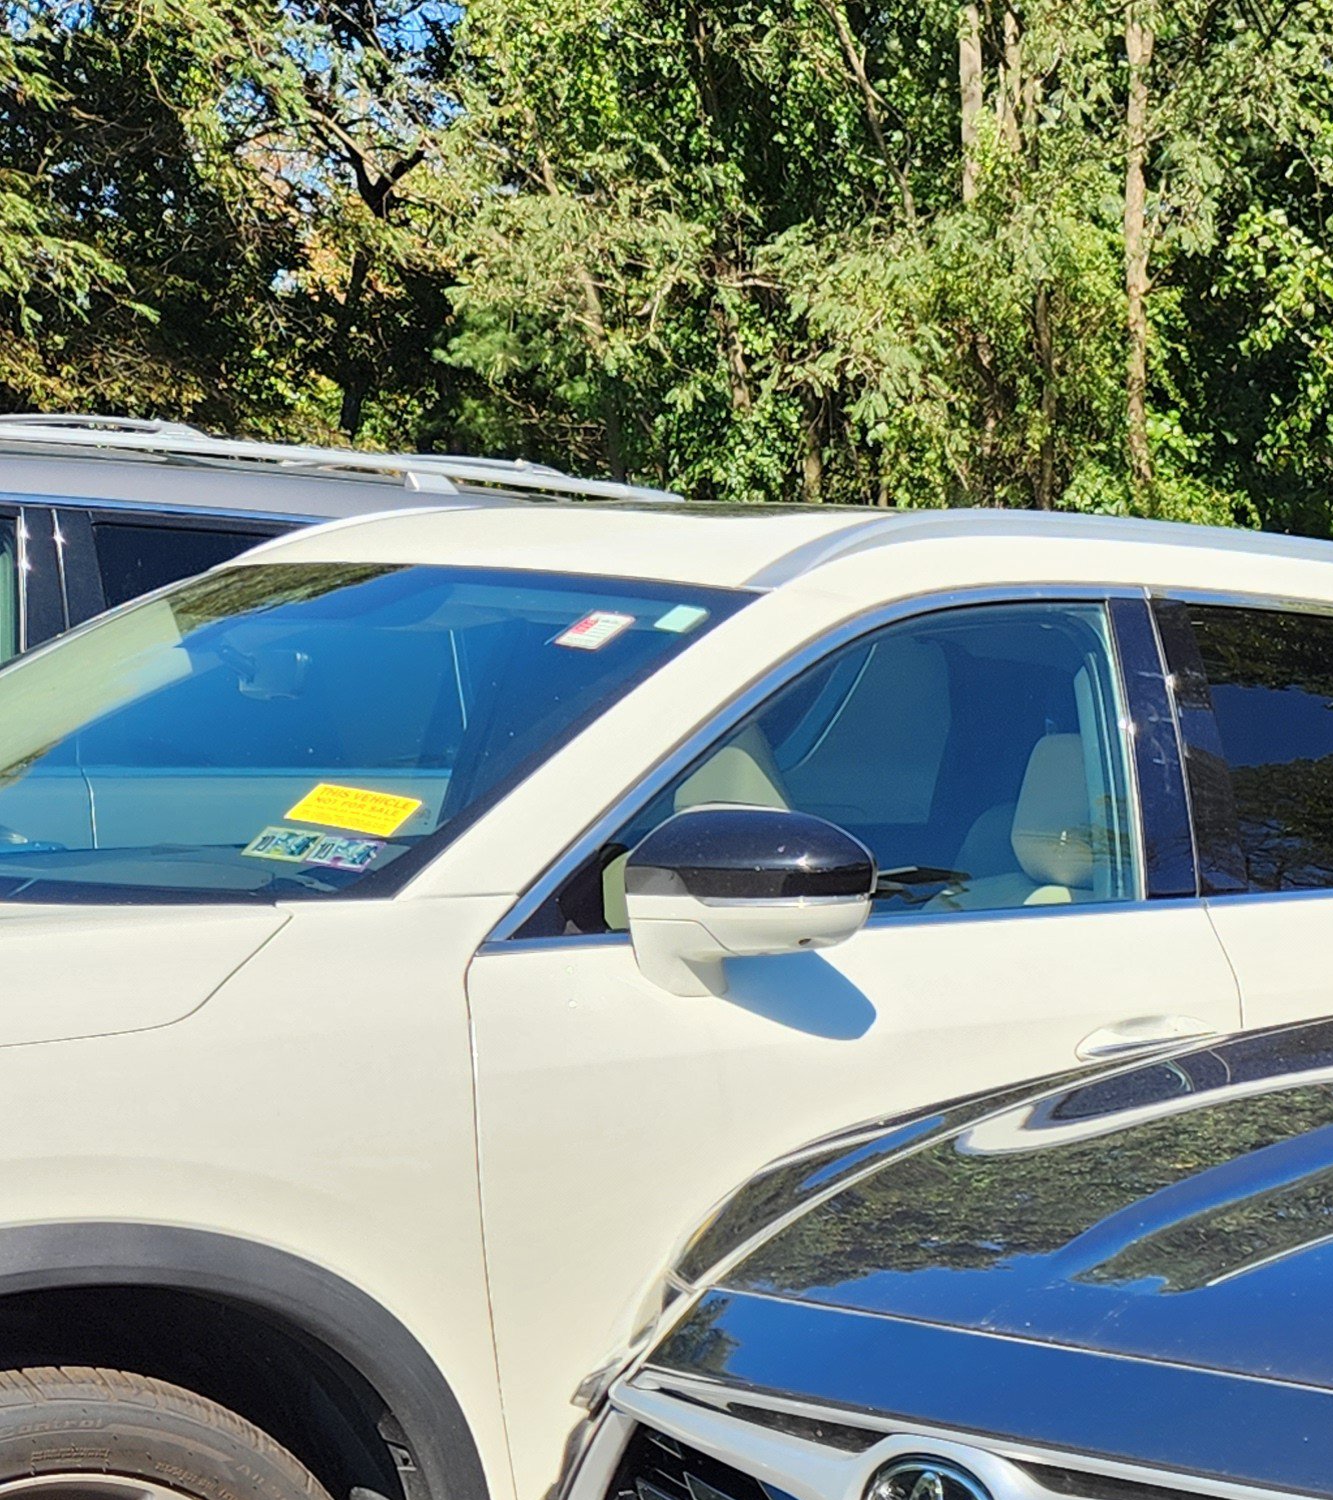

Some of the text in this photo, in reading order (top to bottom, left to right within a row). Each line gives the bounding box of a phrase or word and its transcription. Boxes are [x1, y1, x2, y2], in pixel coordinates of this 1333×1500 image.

[316, 796, 338, 806] NOT
[342, 801, 366, 811] FOR
[369, 805, 400, 817] SALE
[319, 786, 411, 810] THIS VEHICLE
